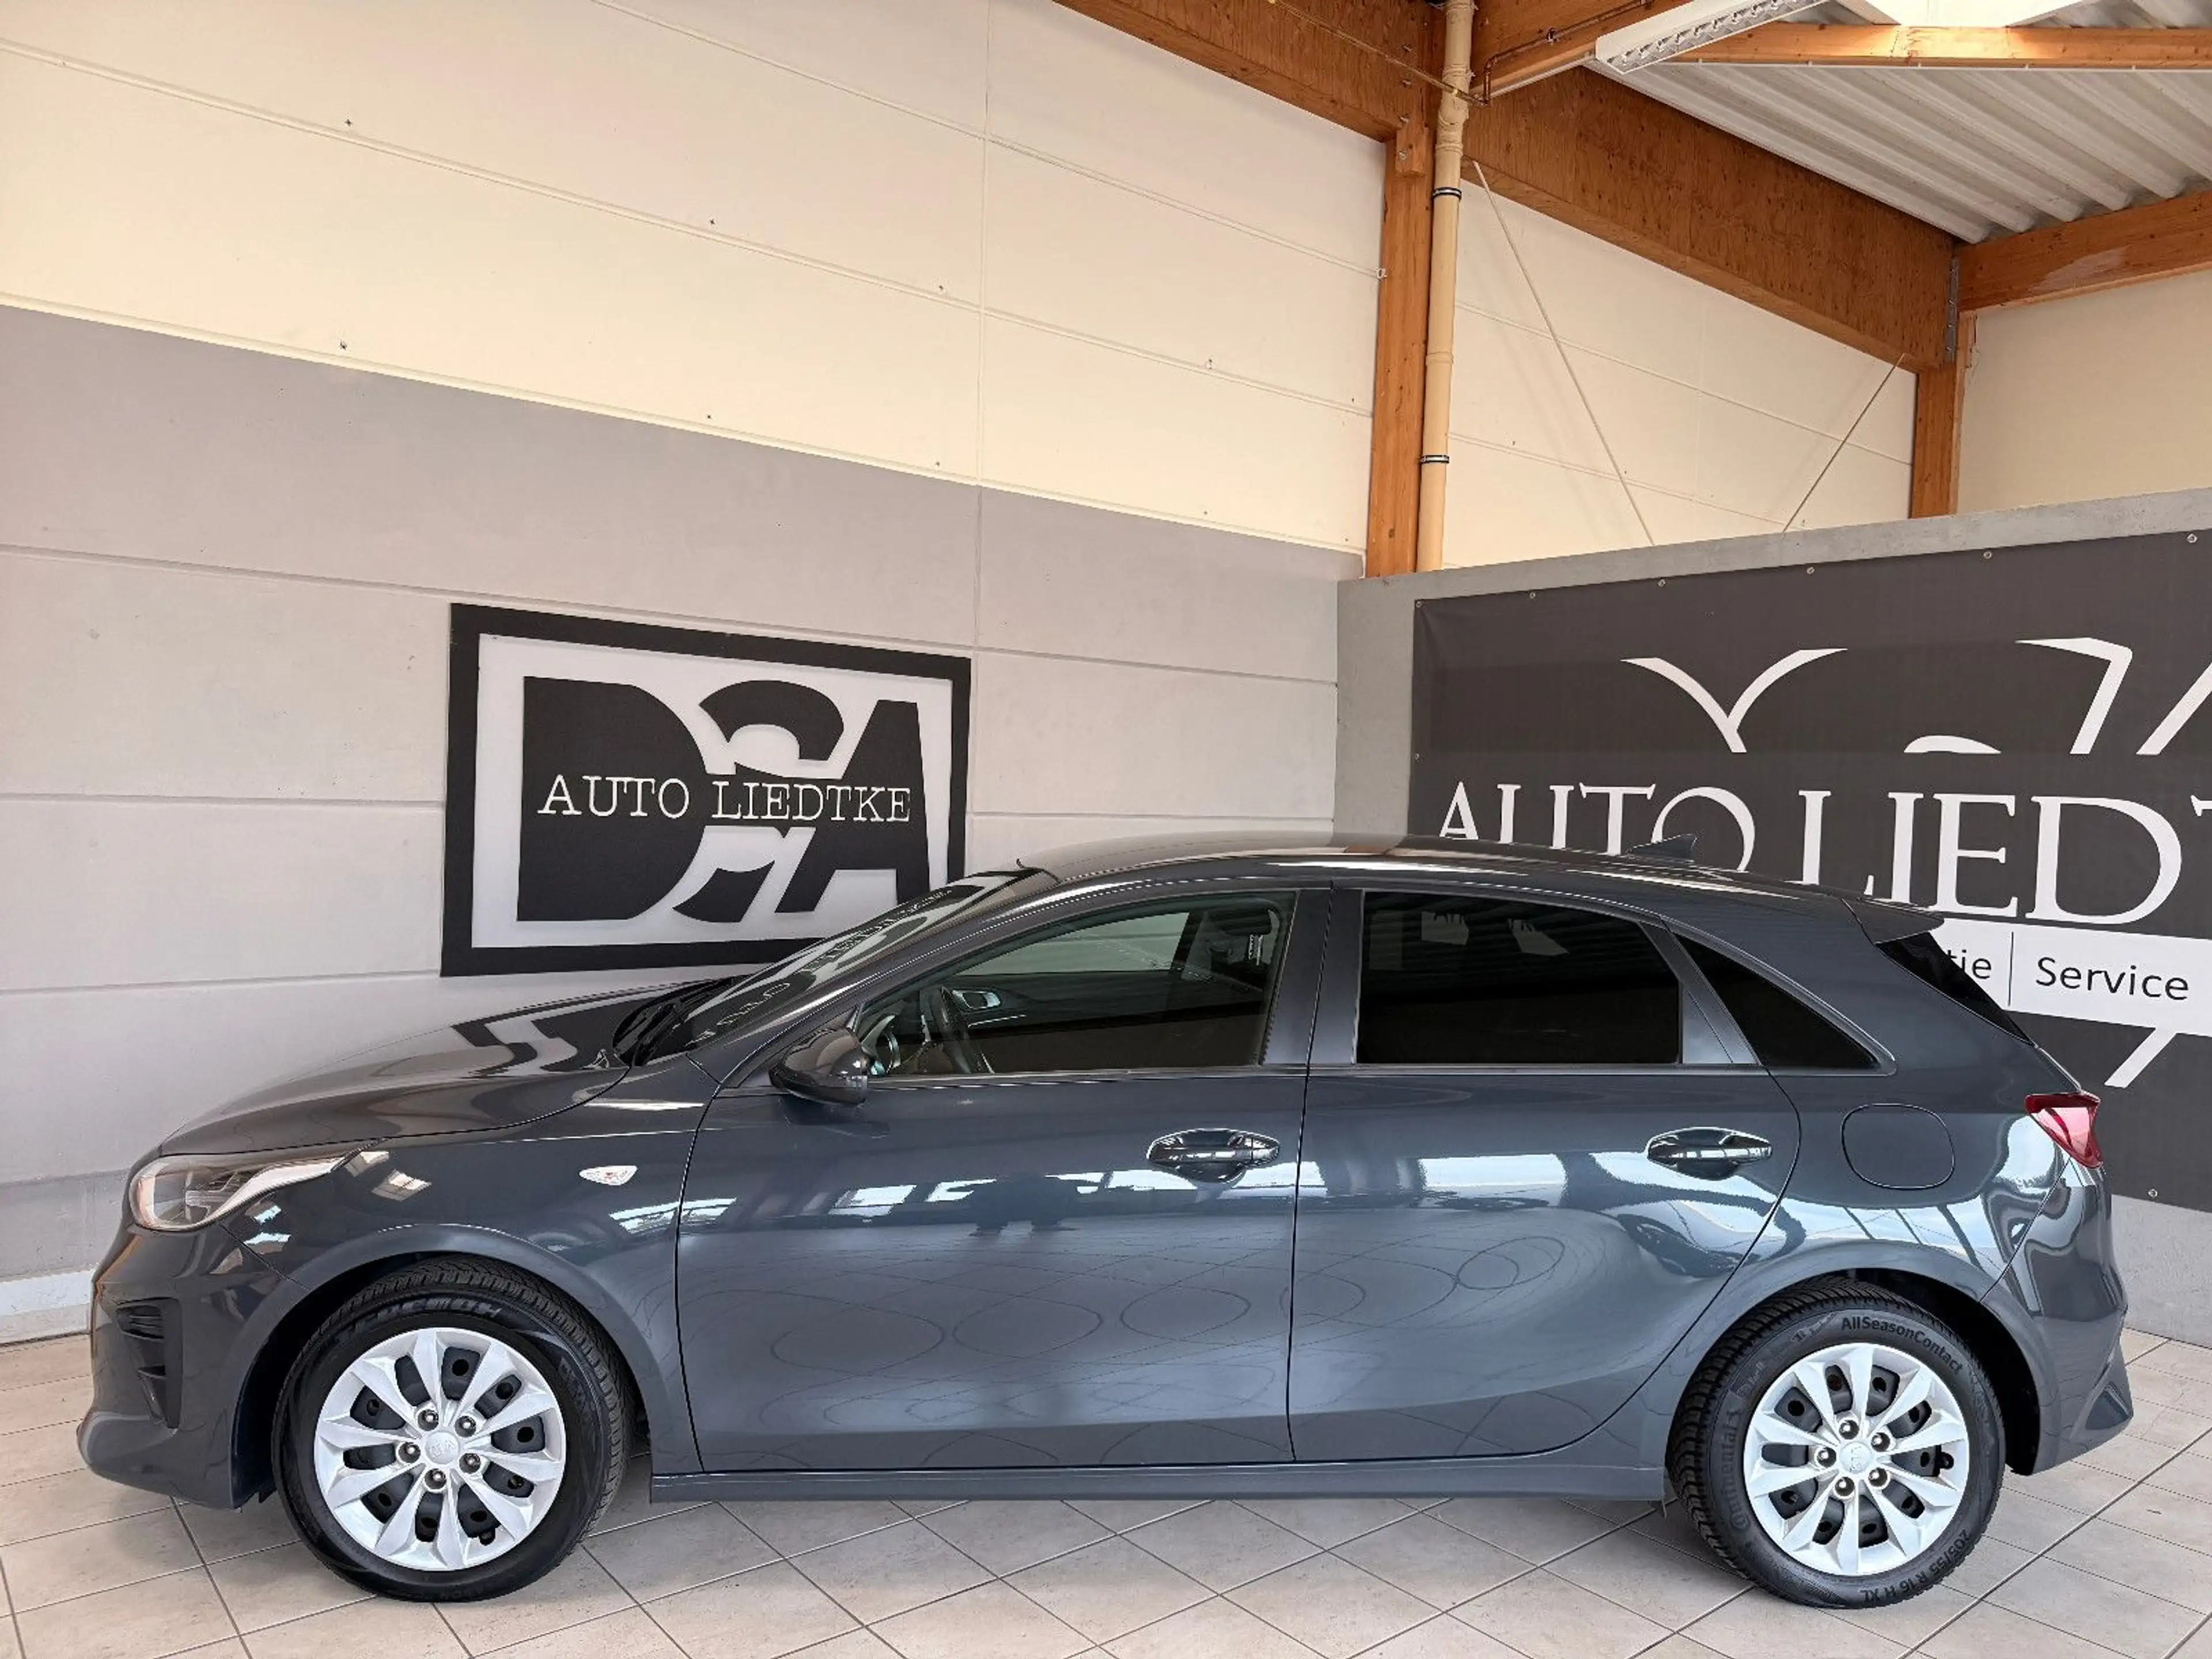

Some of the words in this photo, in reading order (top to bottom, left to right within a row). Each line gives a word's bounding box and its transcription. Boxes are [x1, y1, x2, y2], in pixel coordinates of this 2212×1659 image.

[537, 774, 690, 820] AUTO
[711, 780, 911, 823] LIEDTKE
[1783, 790, 2212, 925] LIED
[2035, 956, 2190, 1001] Service
[1841, 1315, 1963, 1373] AllSeasonContact
